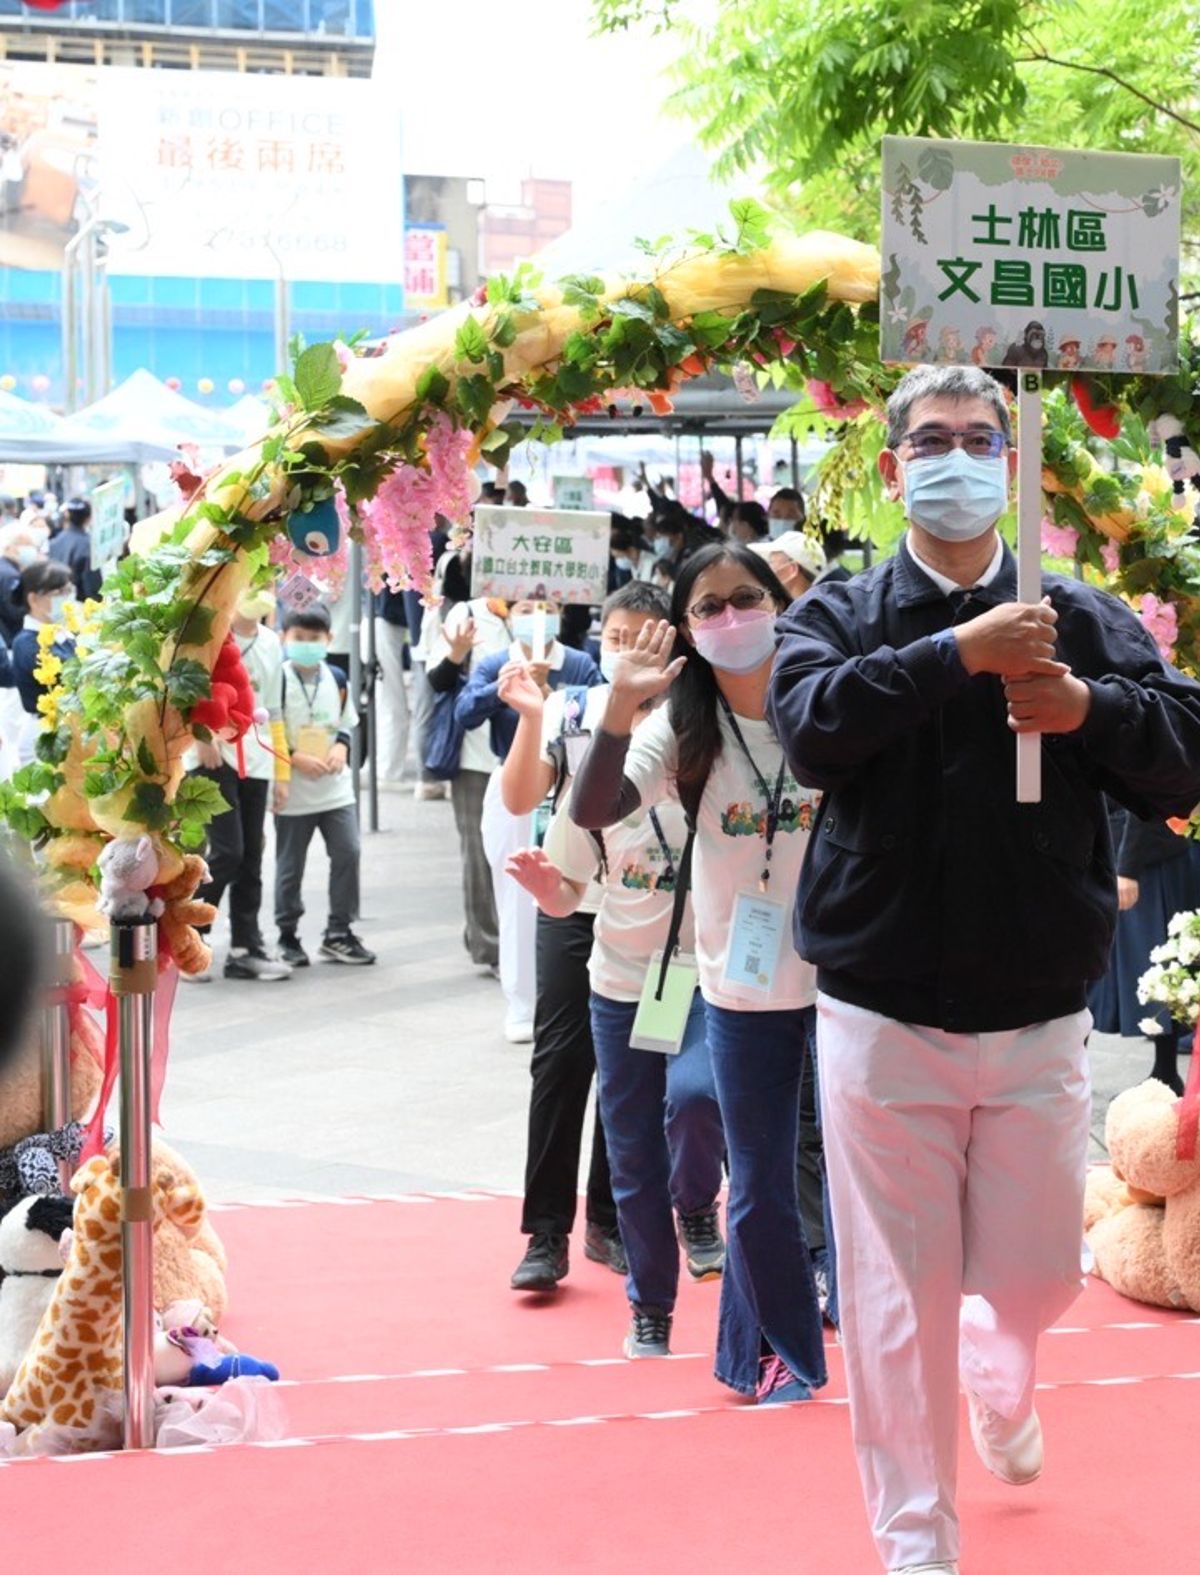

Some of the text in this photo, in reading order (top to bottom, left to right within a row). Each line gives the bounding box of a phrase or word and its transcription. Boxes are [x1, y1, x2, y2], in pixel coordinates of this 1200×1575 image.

[157, 135, 346, 173] 最後兩席
[971, 204, 1107, 251] 士林區
[936, 257, 1139, 311] 文昌國小
[1024, 375, 1039, 392] B
[511, 534, 573, 554] 大安區
